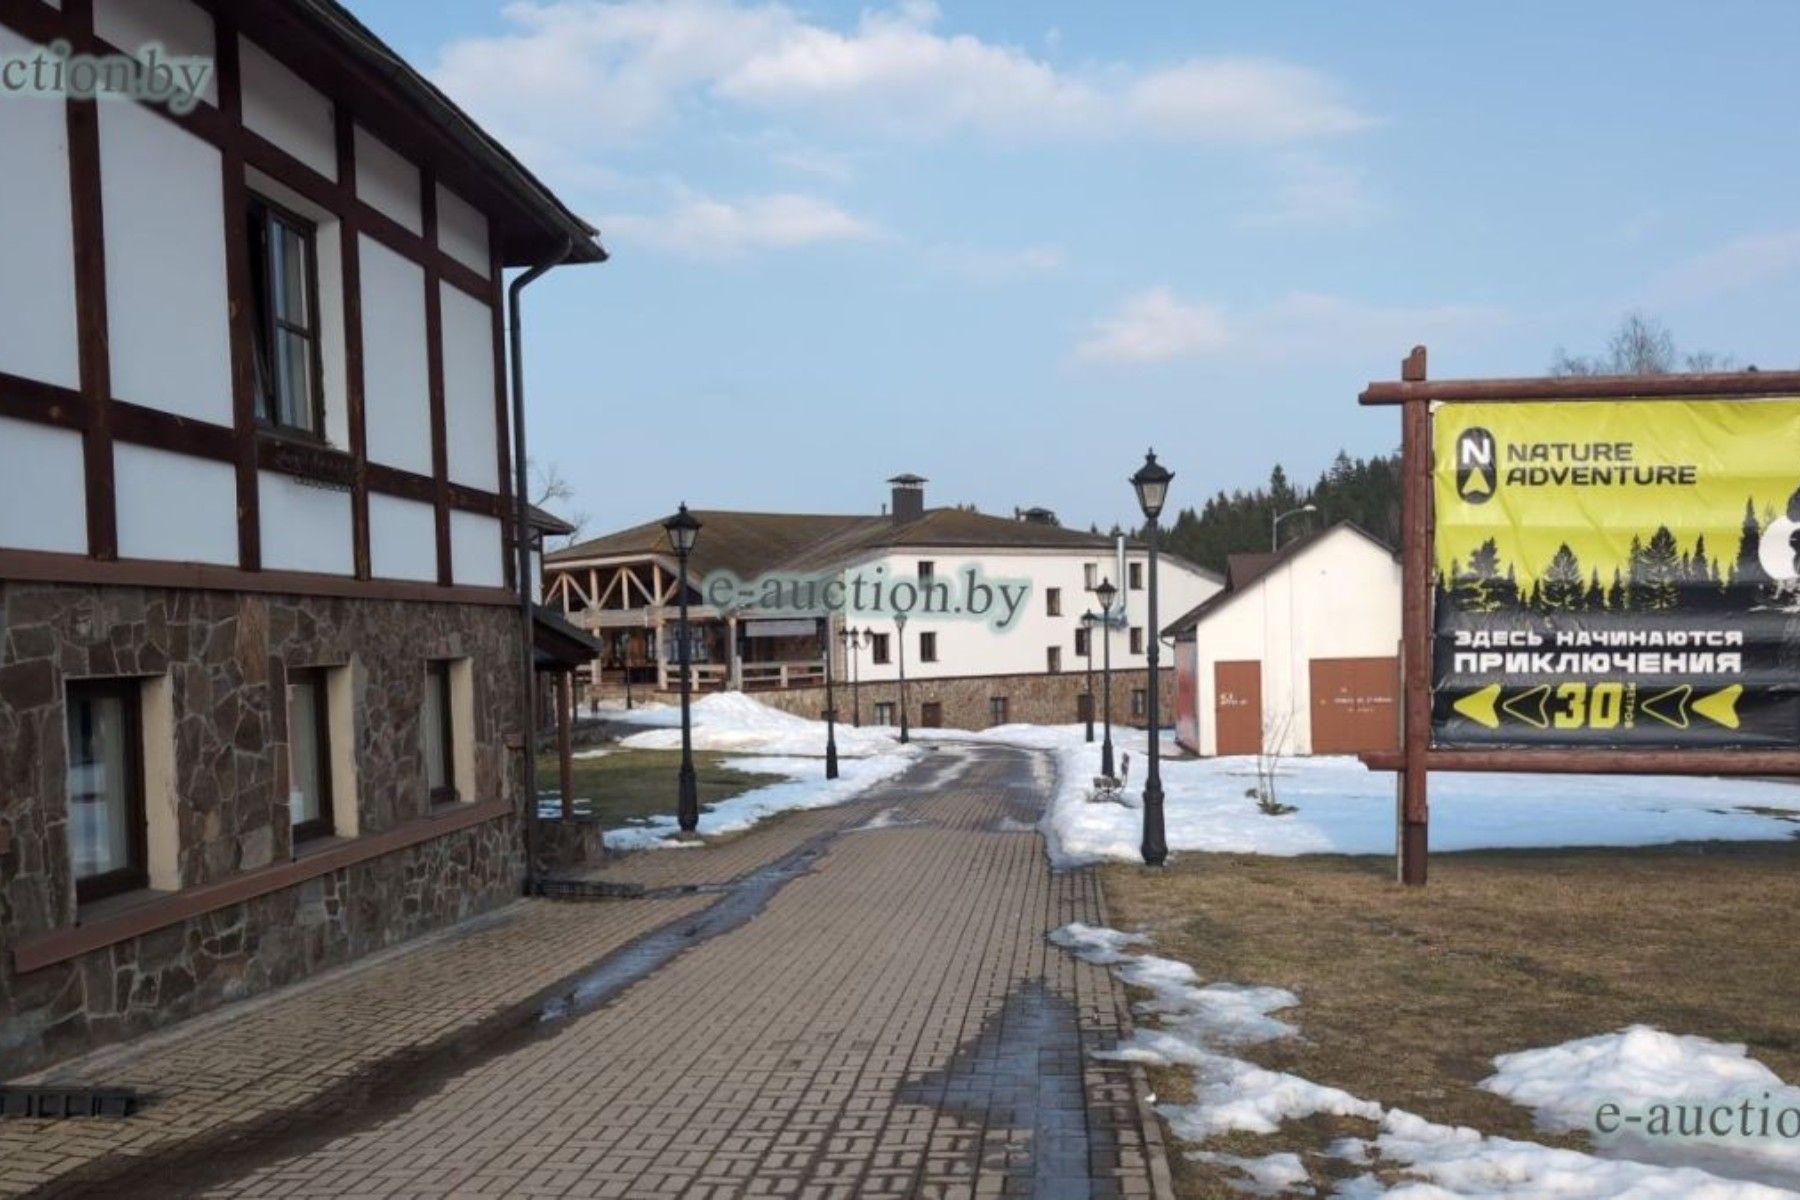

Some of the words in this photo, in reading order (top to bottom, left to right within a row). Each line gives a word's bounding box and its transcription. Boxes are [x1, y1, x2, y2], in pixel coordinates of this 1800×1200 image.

[1507, 442, 1633, 462] NATURE
[1506, 466, 1697, 486] ADVENTURE
[1454, 631, 1543, 648] ЗДЕСЬ
[1557, 630, 1743, 646] НАЧИНАЮТСЯ
[1454, 652, 1742, 674] ПРИКЛЮЧЕНИЯ
[1554, 682, 1622, 729] 30
